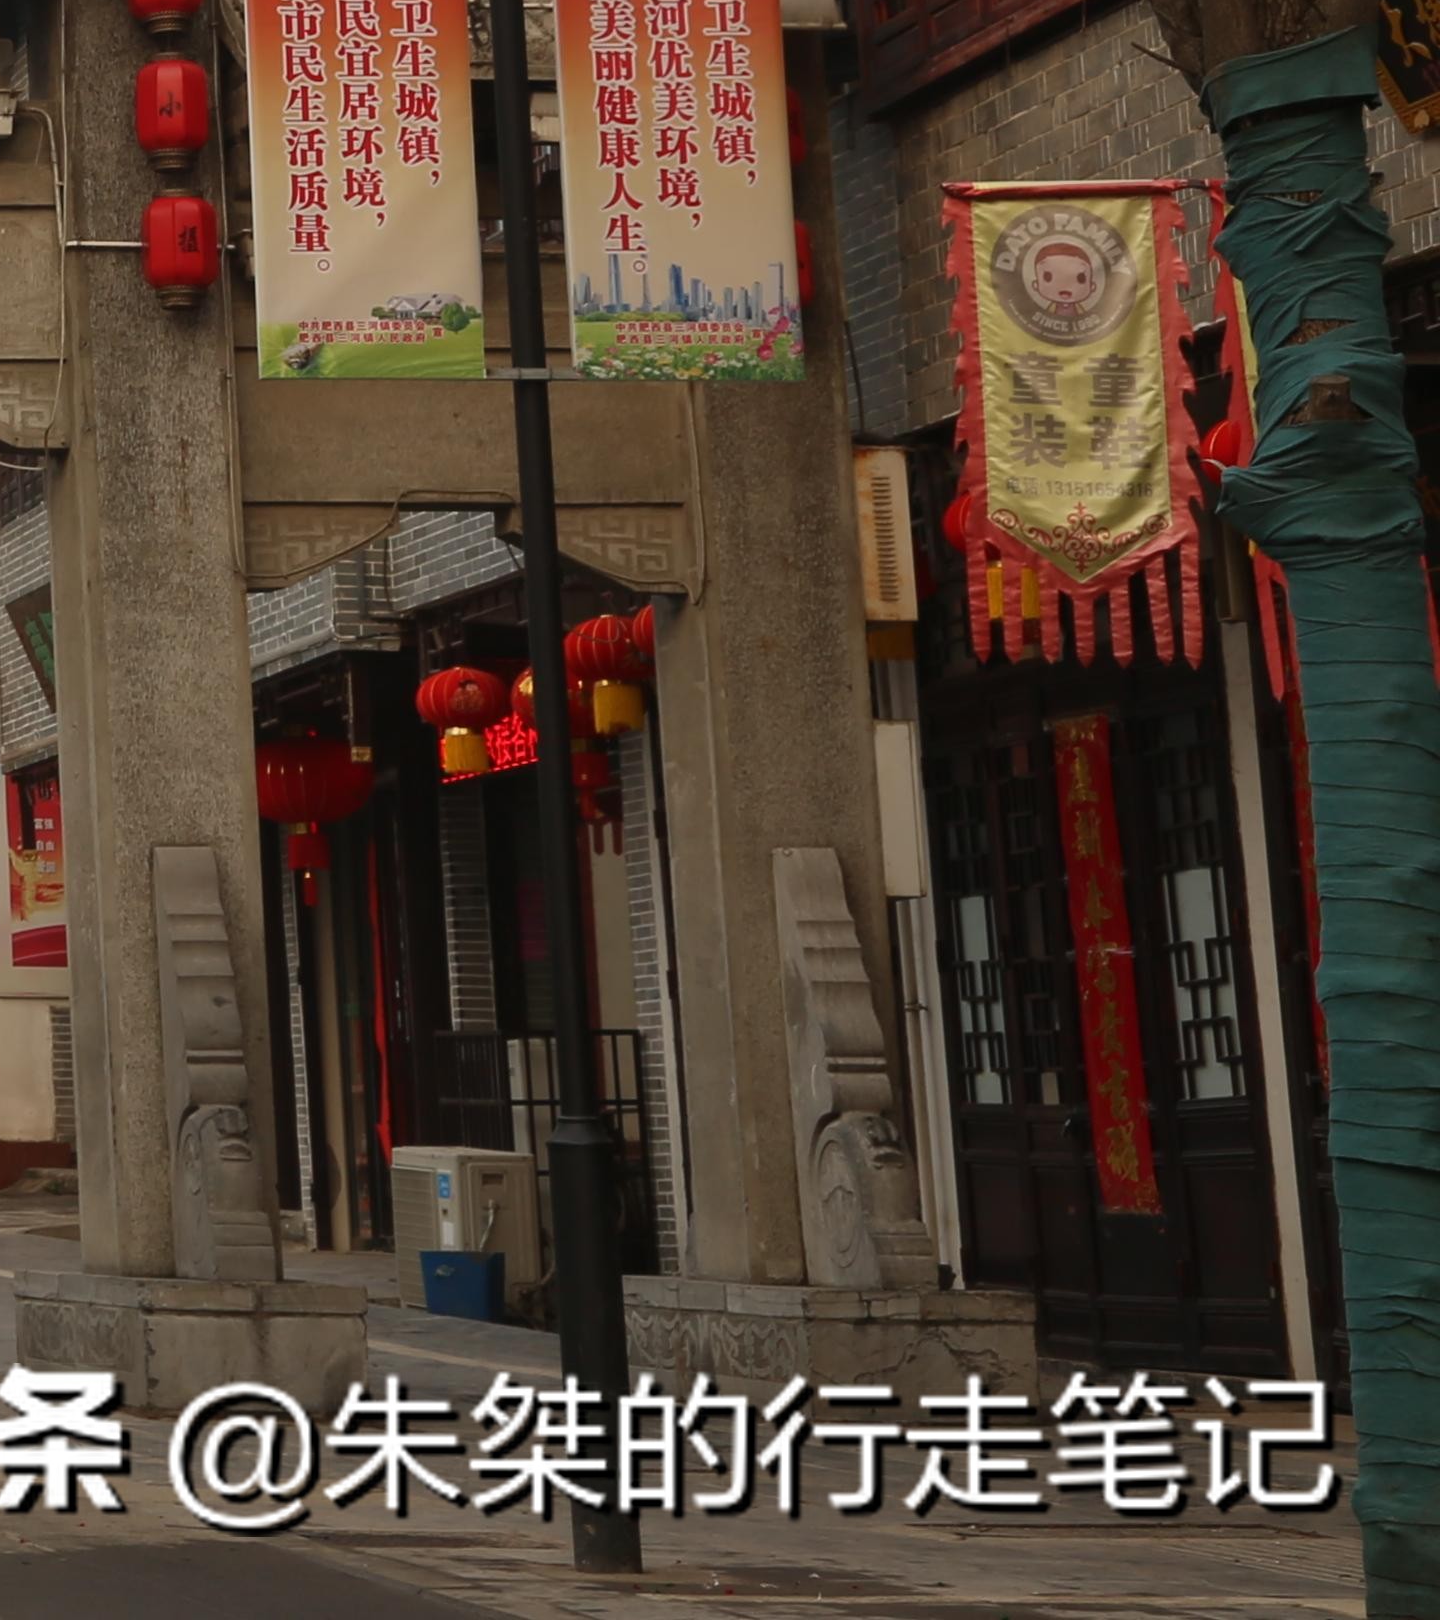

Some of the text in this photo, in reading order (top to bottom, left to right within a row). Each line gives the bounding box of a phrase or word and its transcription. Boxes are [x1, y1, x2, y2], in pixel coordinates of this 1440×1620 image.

[995, 212, 1133, 277] DATO FAMILY
[298, 321, 425, 332] 中共肥西县三河镇委员会
[615, 322, 744, 333] 中共肥西县三河镇委员会
[1032, 312, 1069, 332] SINCE
[298, 333, 425, 344] 肥西县三河镇人民政府
[615, 334, 744, 345] 肥西县三河镇人民政府
[1005, 351, 1068, 469] 童装
[1084, 353, 1152, 470] 童鞋
